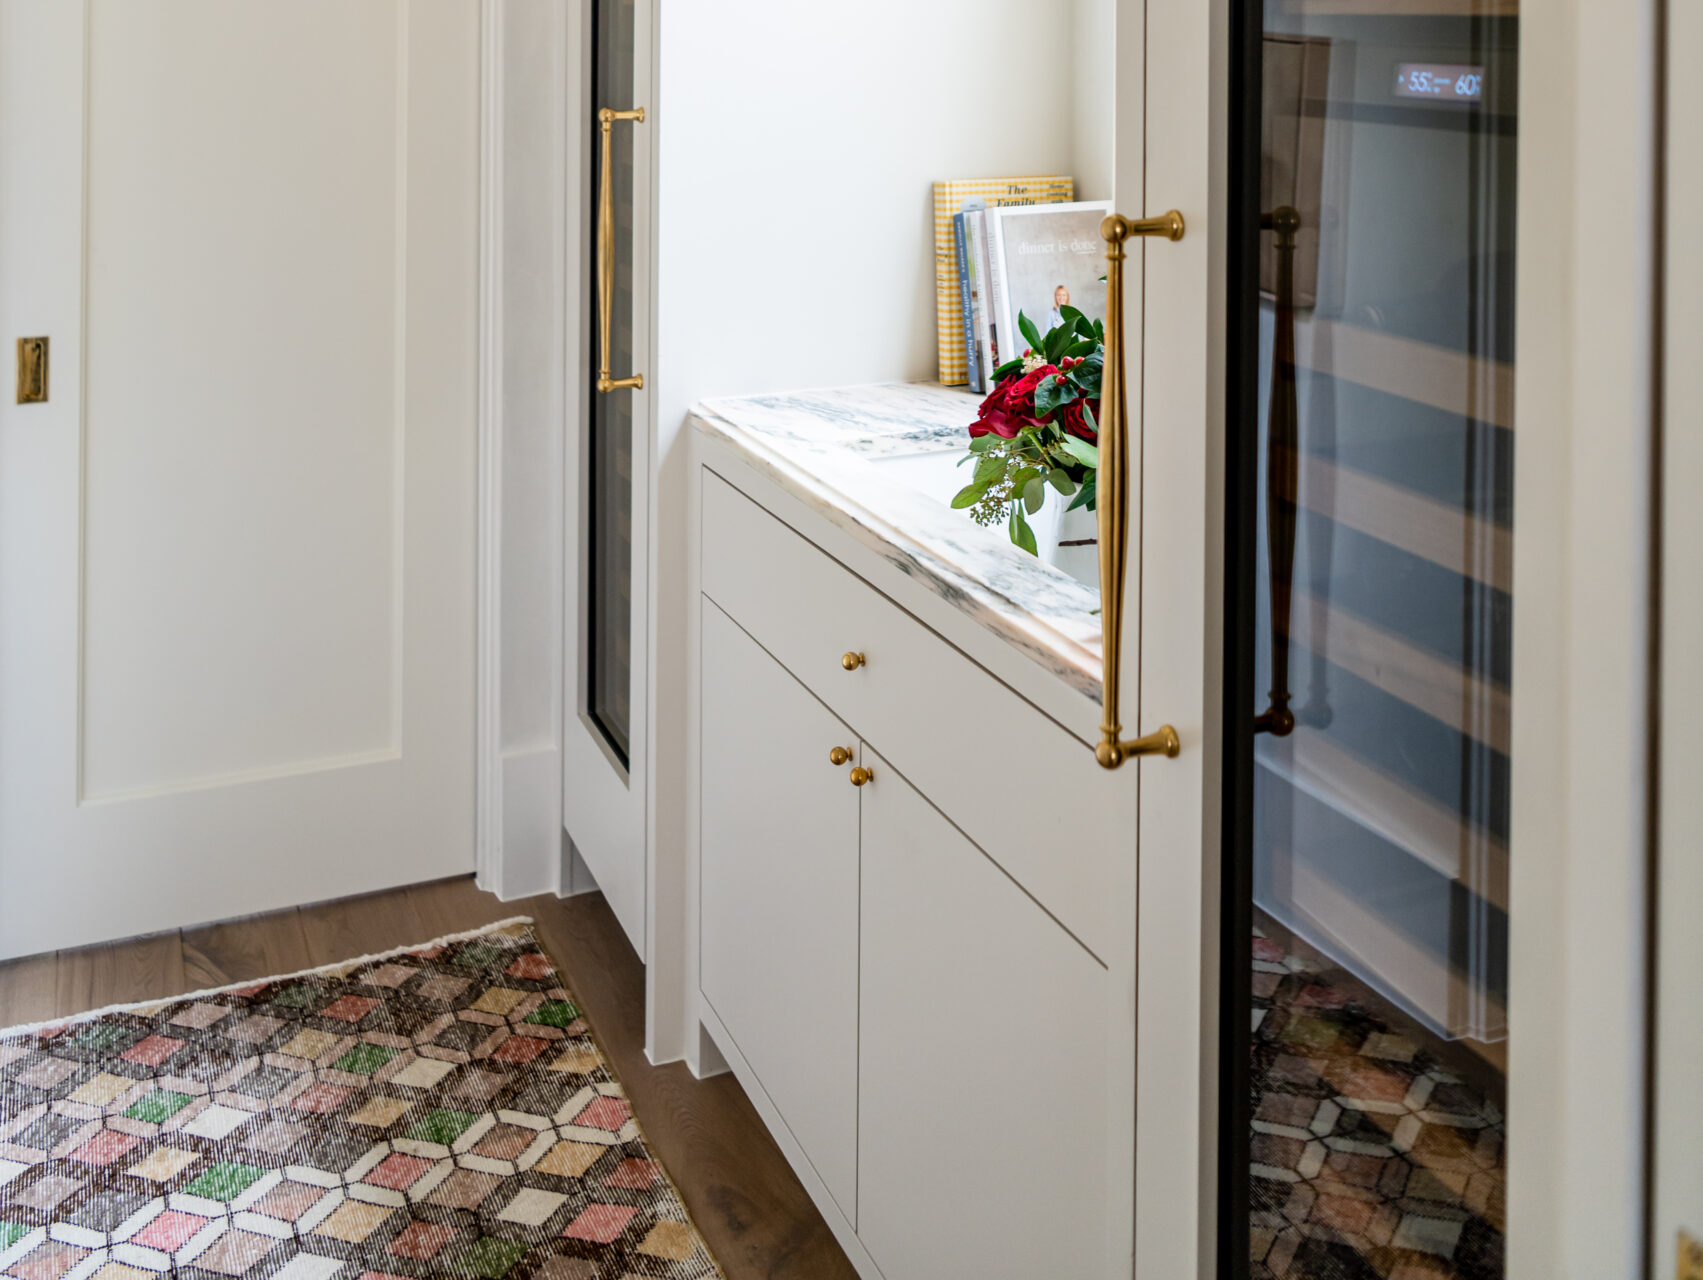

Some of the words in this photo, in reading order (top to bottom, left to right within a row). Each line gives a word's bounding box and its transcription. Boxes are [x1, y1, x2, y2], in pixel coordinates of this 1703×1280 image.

[1007, 184, 1028, 195] The
[1018, 240, 1055, 255] dinner
[1058, 239, 1068, 253] is
[1070, 238, 1097, 253] done
[962, 280, 970, 316] healthy
